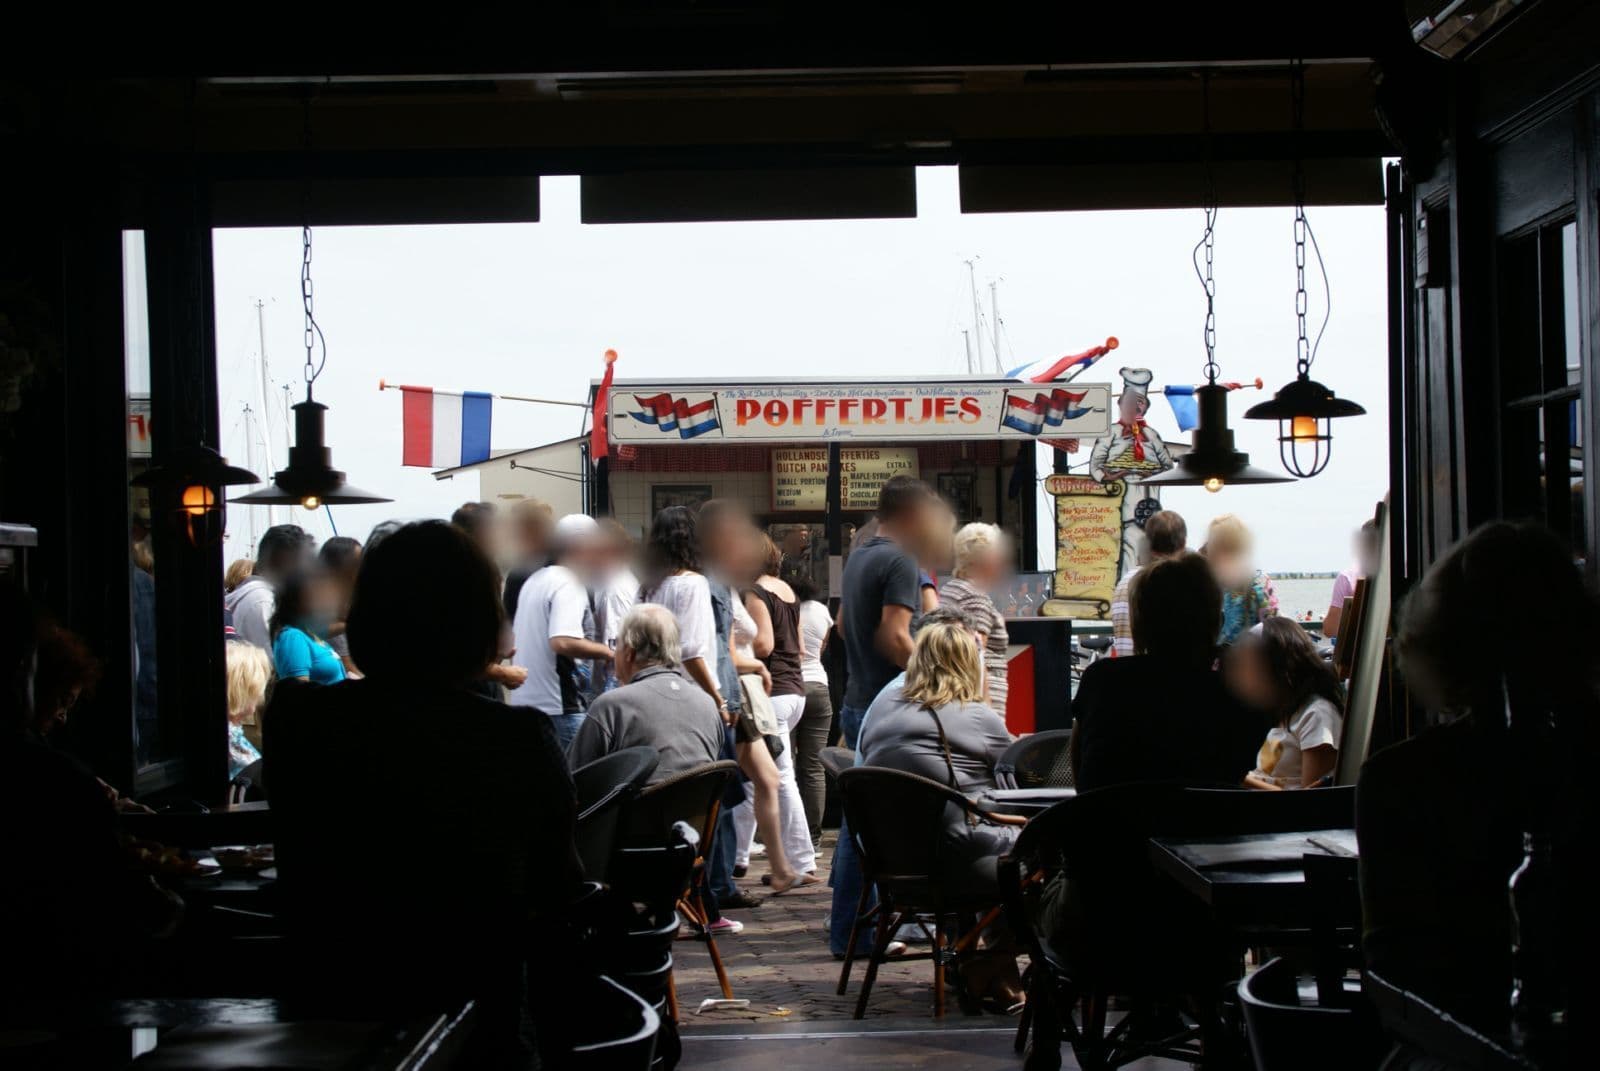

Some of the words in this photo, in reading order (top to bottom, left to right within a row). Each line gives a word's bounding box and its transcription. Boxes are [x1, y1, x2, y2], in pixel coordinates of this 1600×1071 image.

[737, 397, 982, 427] POFFERTJES
[776, 450, 826, 461] HOLLANDSE
[777, 462, 806, 472] DUTCH
[777, 478, 797, 486] SMALL
[800, 477, 826, 486] PORTION
[777, 488, 802, 497] MEDIUM
